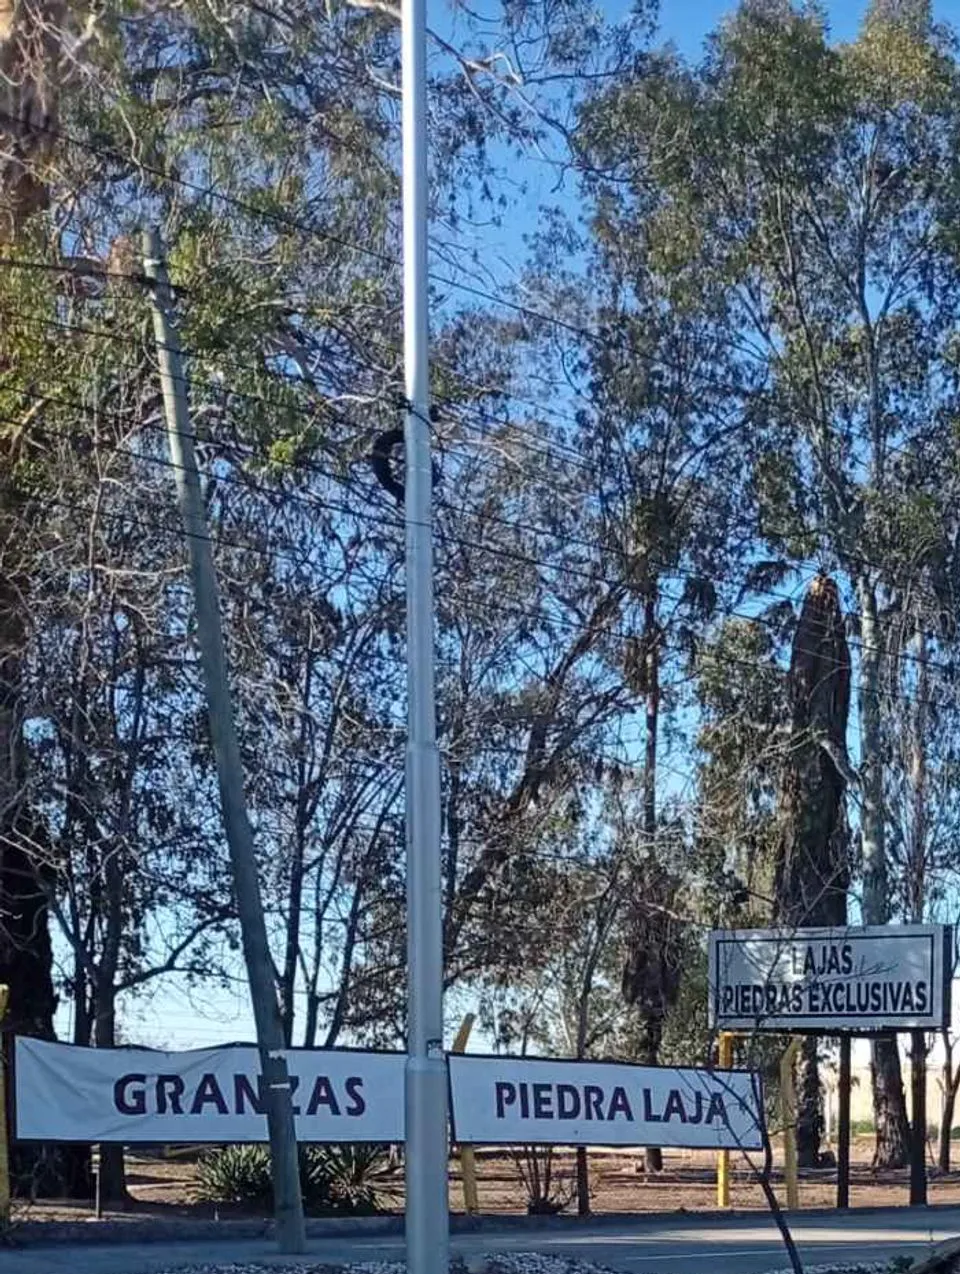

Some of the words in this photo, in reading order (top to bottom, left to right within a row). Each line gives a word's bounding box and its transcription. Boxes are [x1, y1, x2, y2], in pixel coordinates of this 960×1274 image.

[792, 946, 853, 975] LAJAS
[723, 982, 804, 1013] PIEDRAS
[808, 981, 927, 1012] EXCLUSIVAS
[495, 1082, 634, 1121] PIEDRA
[643, 1088, 728, 1125] LAJA
